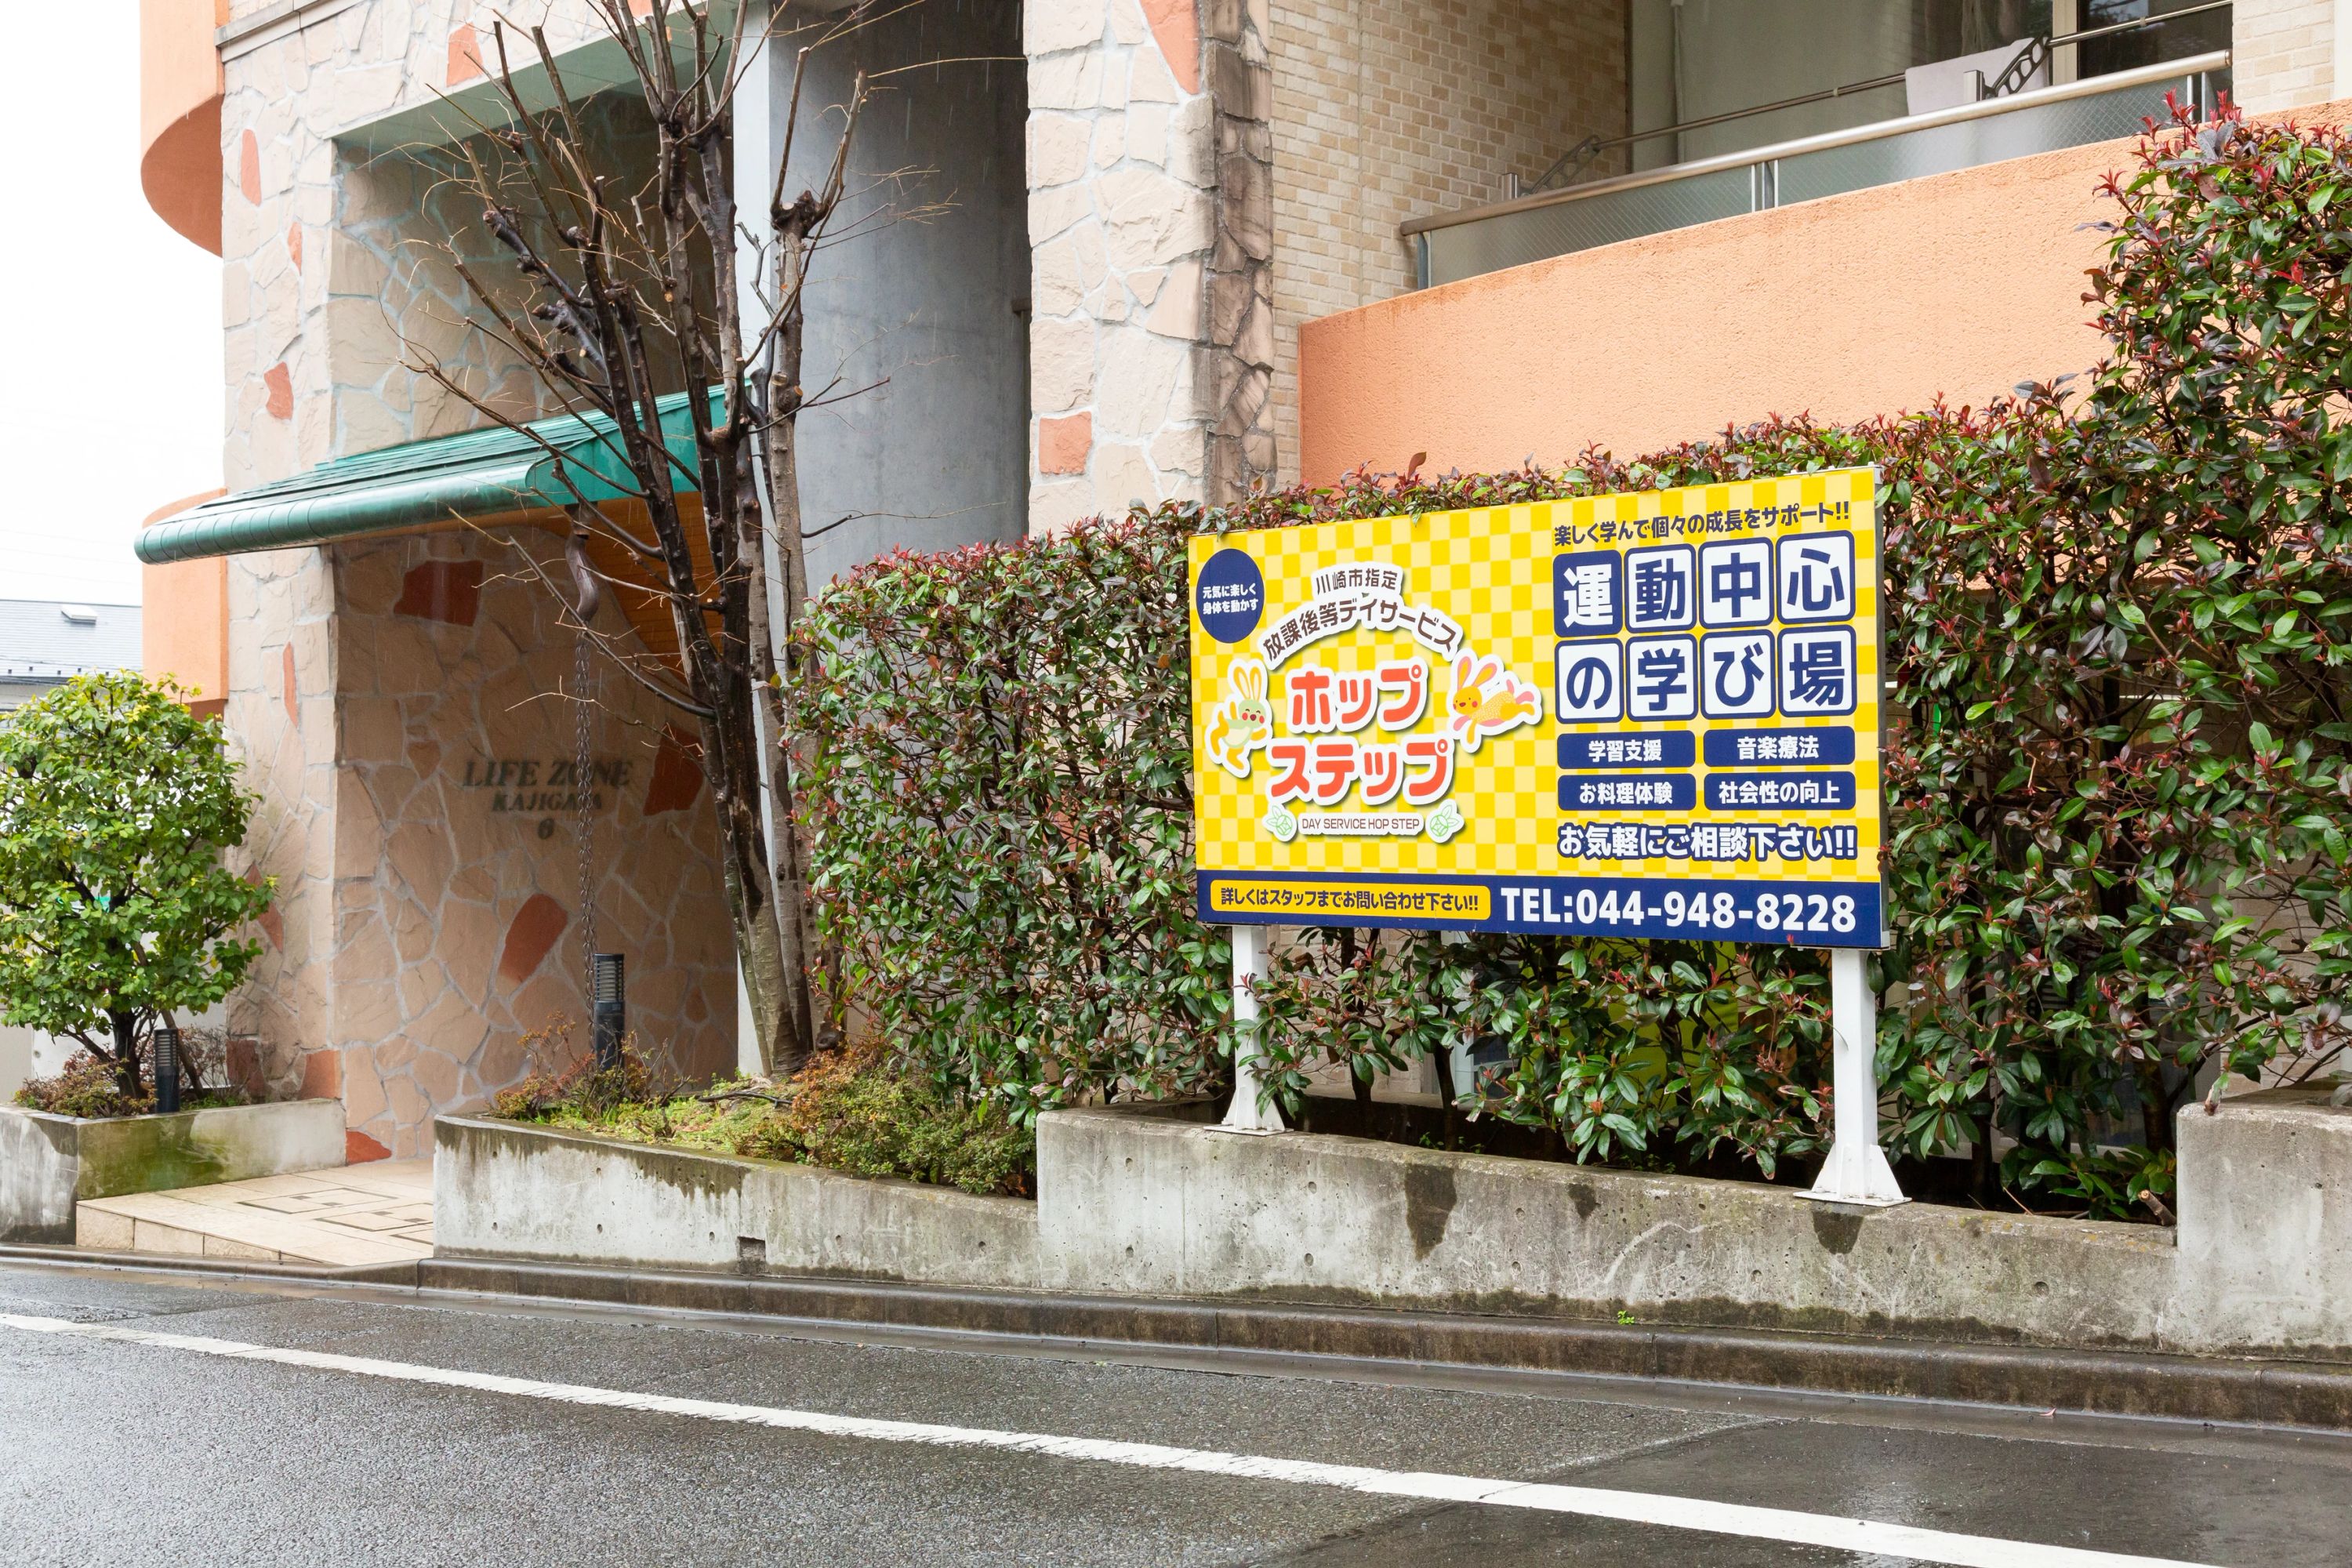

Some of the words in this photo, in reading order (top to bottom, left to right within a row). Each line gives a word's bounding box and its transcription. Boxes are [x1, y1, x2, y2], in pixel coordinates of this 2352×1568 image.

[1554, 501, 1849, 546] 楽しく学んで個々の成長をサポート!!
[1202, 583, 1257, 599] 元気に楽しく
[1316, 568, 1399, 595] 川崎市指定
[1563, 547, 1846, 628] 運動中心
[1202, 598, 1259, 615] 身体を動かす
[1262, 597, 1457, 662] 放課後等デイサービス
[1565, 640, 1846, 712] の学び場
[1290, 664, 1422, 726] ホップ
[1588, 739, 1663, 763] 学習支援
[1737, 735, 1820, 760] 音楽療法
[463, 759, 540, 787] LIFE
[1270, 739, 1449, 798] ステップ
[491, 793, 603, 811] KAJIGAA
[1578, 781, 1673, 804] お料理体験
[1719, 779, 1841, 804] 社会性の向上
[1302, 818, 1321, 829] DAY
[1323, 818, 1367, 829] SERVICE
[1368, 818, 1389, 829] HOP
[1392, 818, 1420, 829] STEP
[1558, 823, 1857, 860] お気軽にご相談下さい!!
[1220, 887, 1479, 912] 詳しくはスタッフまでお問い合わせ下さい!!
[1501, 887, 1857, 933] TEL:044-948-8228
